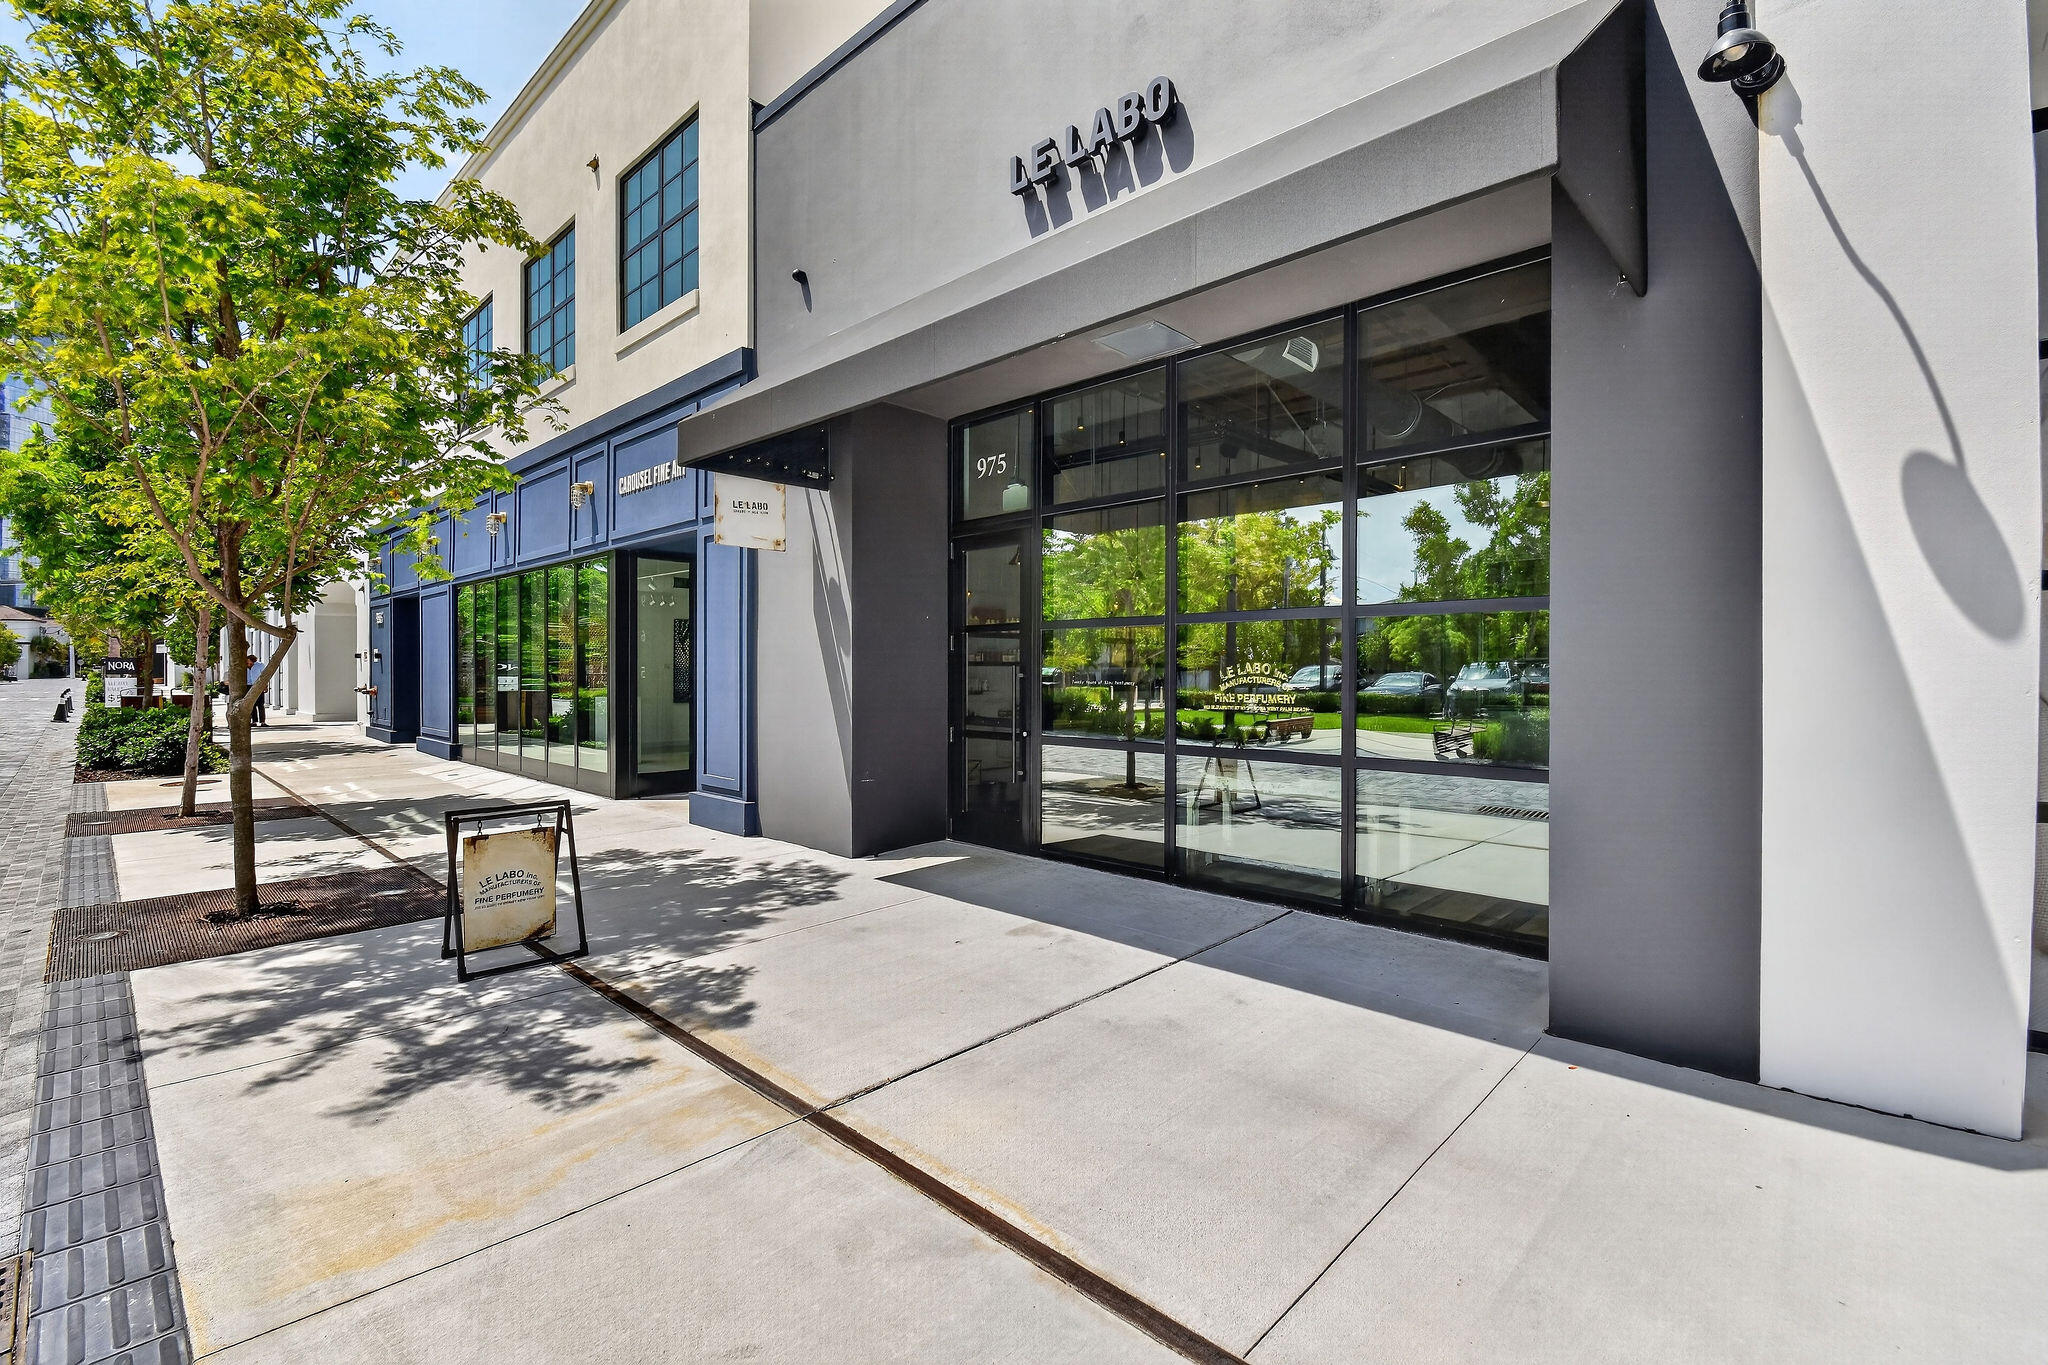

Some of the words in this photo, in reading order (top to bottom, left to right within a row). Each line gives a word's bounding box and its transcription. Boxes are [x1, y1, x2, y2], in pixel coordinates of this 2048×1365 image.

[1010, 137, 1055, 195] LE
[1065, 75, 1174, 167] LABO
[976, 453, 1007, 479] 975
[618, 468, 652, 495] CAROUSEL
[653, 461, 671, 484] FINE
[732, 500, 744, 509] LE
[746, 501, 769, 511] LABO
[107, 661, 135, 671] NORA
[1219, 666, 1235, 681] LE
[1237, 662, 1271, 676] LABO
[1219, 675, 1281, 692] MANUFACTURERS
[1214, 693, 1235, 703] FINE
[1237, 693, 1297, 704] PERFUMERY
[479, 876, 493, 888] LE
[495, 869, 524, 882] LABO
[479, 880, 532, 895] MANUFACTURERS
[474, 896, 493, 905] FINE
[495, 886, 545, 902] PERFUMERY
